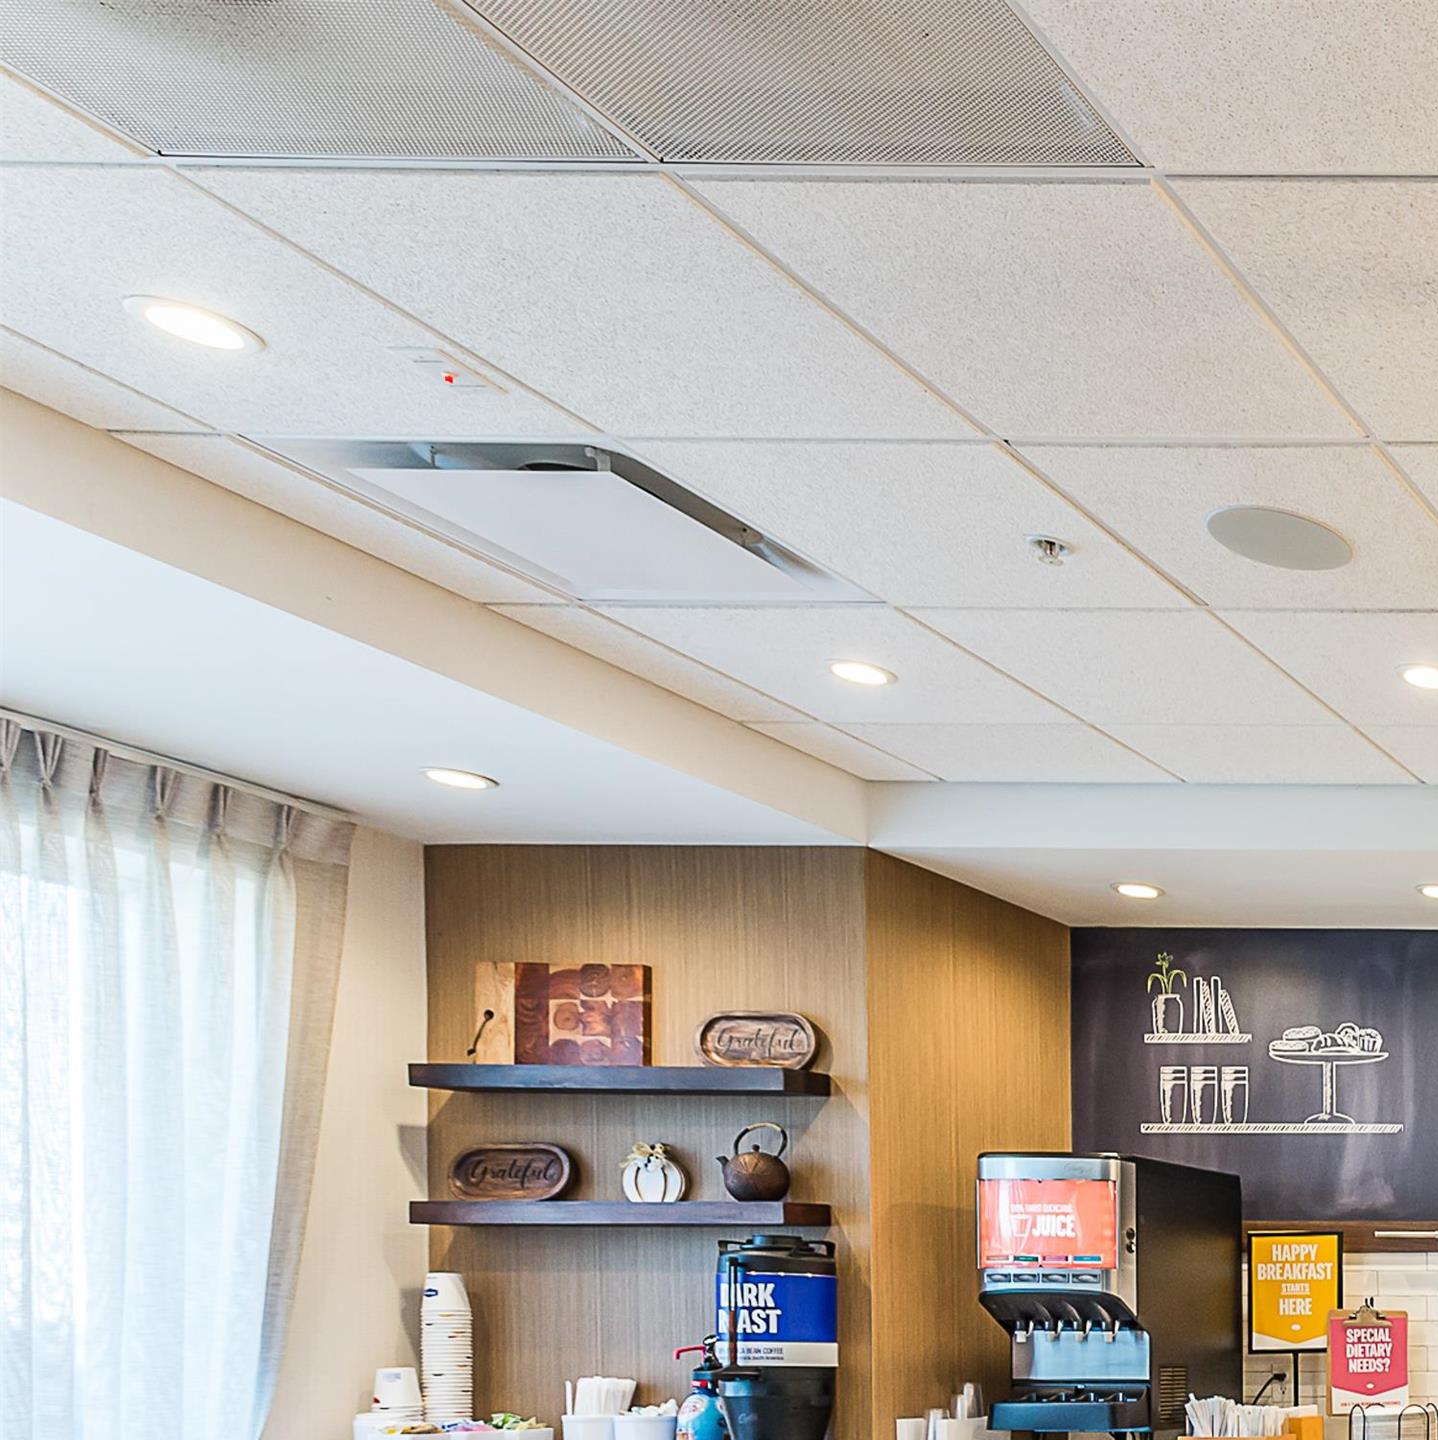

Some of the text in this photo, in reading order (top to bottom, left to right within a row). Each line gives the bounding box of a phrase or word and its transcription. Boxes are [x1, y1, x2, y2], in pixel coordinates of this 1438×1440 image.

[716, 1025, 799, 1059] Grateful
[468, 1156, 556, 1188] Grateful
[1032, 1214, 1076, 1238] JUICE
[1271, 1244, 1318, 1262] HAPPY
[1257, 1262, 1333, 1281] BREAKFAST
[1281, 1283, 1310, 1293] STARTS
[1279, 1298, 1312, 1315] HERE
[1346, 1328, 1392, 1342] SPECIAL
[1346, 1343, 1393, 1358] DIETARY
[1348, 1358, 1391, 1373] NEEDS?
